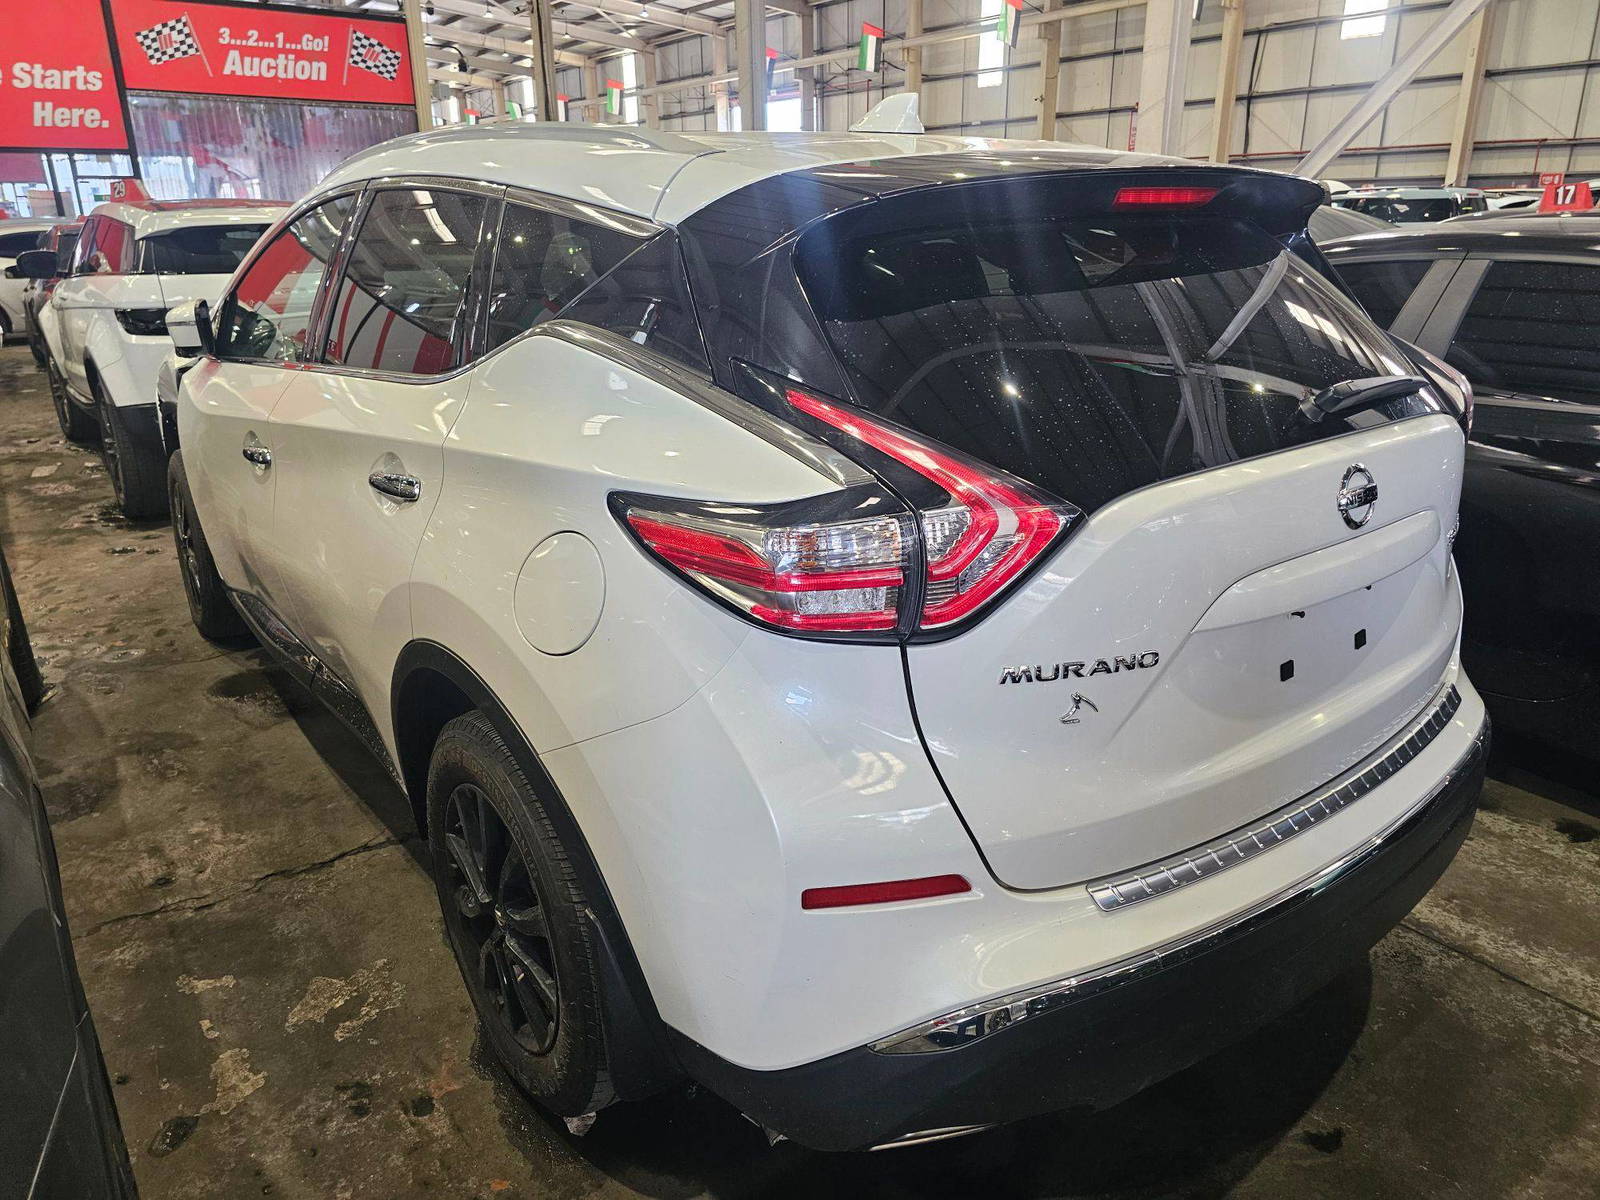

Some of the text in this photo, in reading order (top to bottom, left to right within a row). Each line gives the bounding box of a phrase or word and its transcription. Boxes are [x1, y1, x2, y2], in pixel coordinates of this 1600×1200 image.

[12, 62, 103, 91] Starts
[222, 49, 328, 81] Auction
[33, 101, 110, 128] Here.
[113, 181, 126, 198] 29
[1556, 185, 1576, 205] 17
[999, 650, 1160, 684] MURANO
